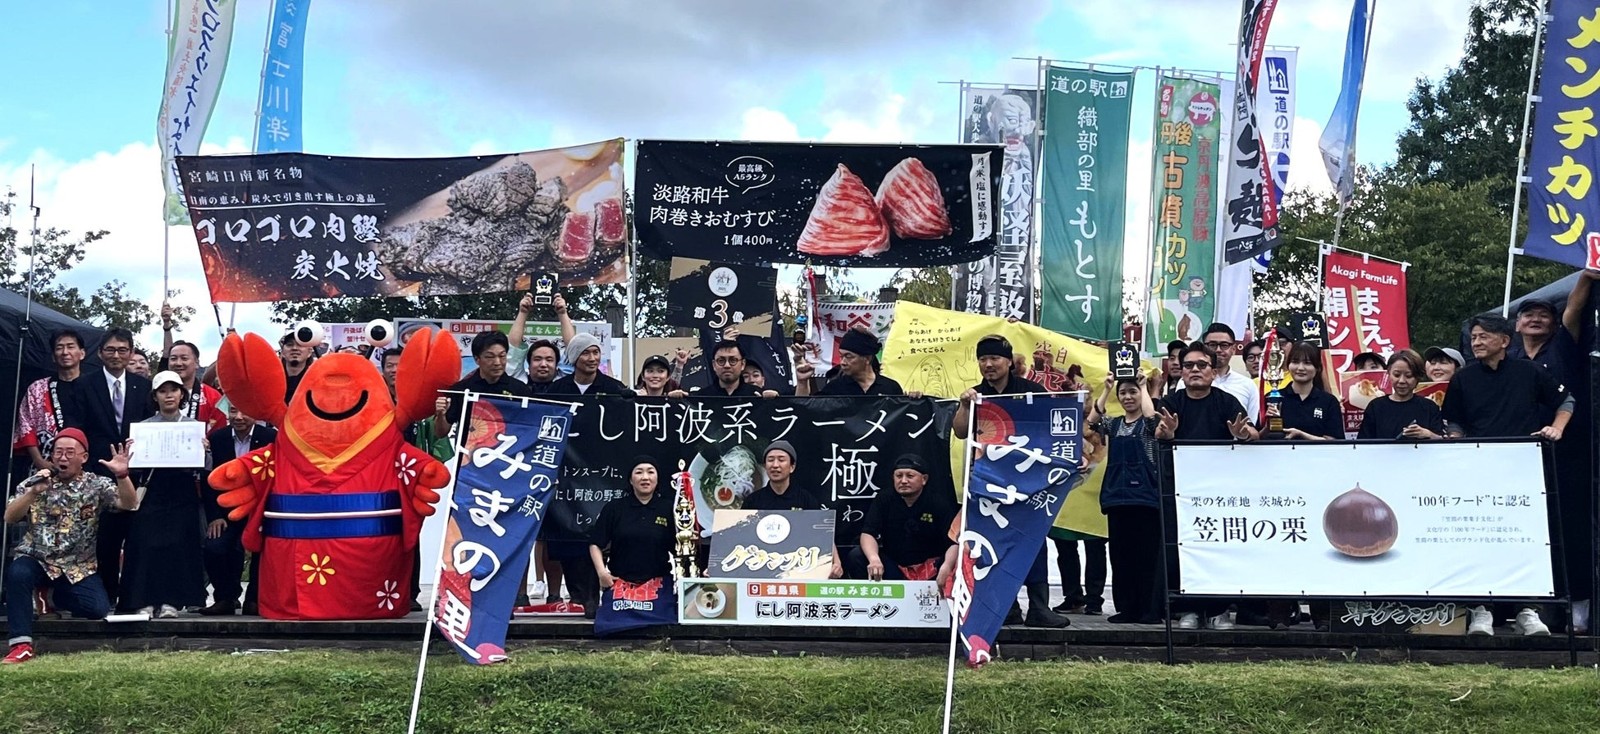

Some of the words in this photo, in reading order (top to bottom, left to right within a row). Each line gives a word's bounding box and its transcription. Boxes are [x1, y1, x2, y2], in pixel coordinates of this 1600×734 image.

[266, 22, 294, 154] 富士川楽
[1051, 75, 1107, 97] 道の駅
[1160, 122, 1193, 147] 丹後
[1273, 96, 1290, 150] 道の駅
[1076, 105, 1098, 192] 織部の里
[188, 166, 303, 184] 宮崎日南新名物
[733, 173, 768, 182] A5ランク
[738, 163, 764, 173] 最高級
[652, 183, 730, 205] 淡路和牛
[649, 205, 777, 228] 肉巻きおむすび
[1159, 151, 1188, 285] 古墳カツ
[723, 233, 773, 247] 1個400円
[290, 249, 386, 281] 炭火焼
[1065, 201, 1100, 323] もとす
[1330, 265, 1358, 280] Akagi
[1361, 270, 1399, 286] FarmLife
[518, 443, 560, 521] 道の駅
[820, 443, 880, 501] 極
[1025, 440, 1079, 516] 道の駅
[555, 488, 629, 502] にし阿波の野菜
[1190, 496, 1251, 508] 栗の名産地
[1258, 496, 1308, 508] 茨城から
[1192, 515, 1309, 544] 笠間の栗
[434, 433, 533, 662] みまの里
[720, 544, 822, 573] グランプリ
[750, 585, 759, 594] 9
[766, 584, 799, 595] 徳島県
[819, 586, 845, 595] 道の駅
[847, 585, 893, 597] みまの里
[756, 601, 898, 619] にし阿波系ラーメン
